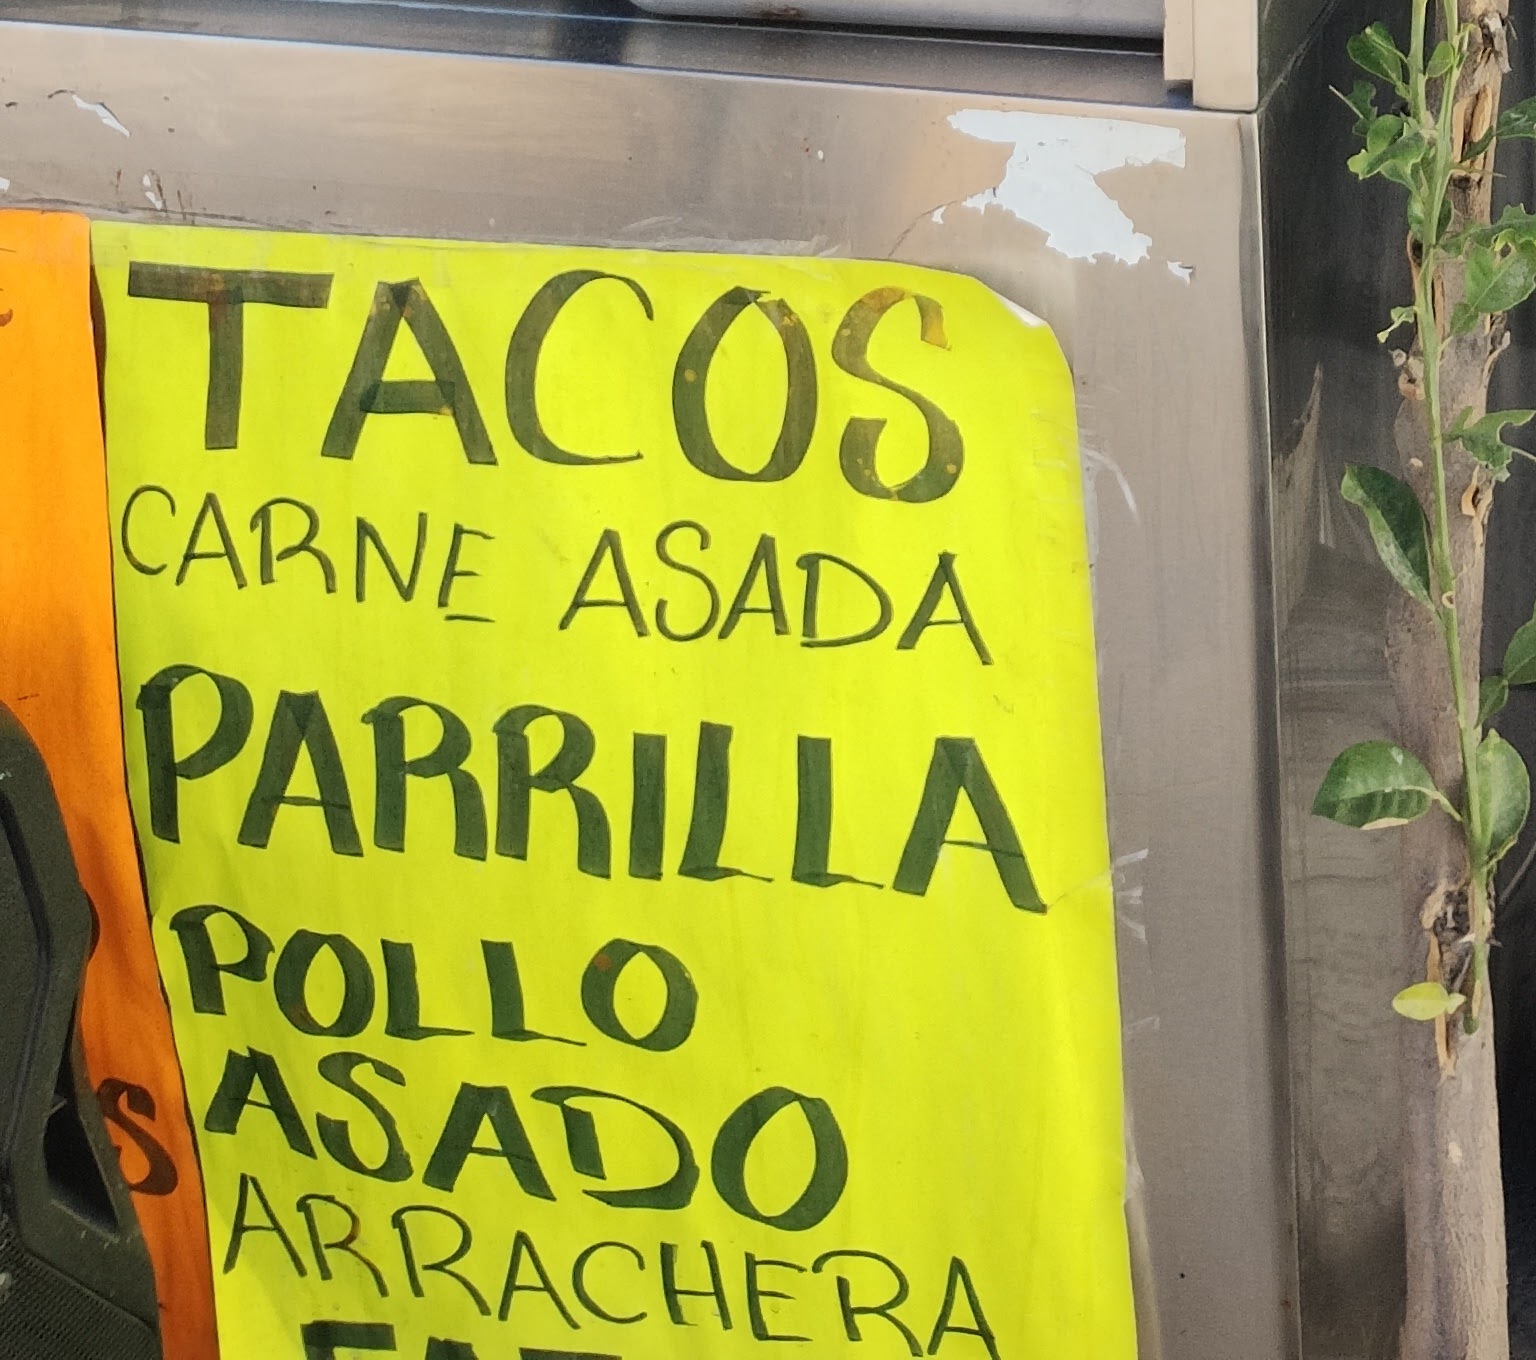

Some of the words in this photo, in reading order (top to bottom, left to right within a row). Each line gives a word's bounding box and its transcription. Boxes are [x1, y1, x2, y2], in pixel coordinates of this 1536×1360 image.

[126, 260, 966, 504] TACOS
[121, 484, 498, 623] CARNE
[559, 519, 993, 666] ASADA
[135, 663, 1048, 914] PARRILLA
[170, 903, 699, 1053] POLLO
[203, 1047, 849, 1232] ASADO
[222, 1173, 999, 1360] ARRACHERA
